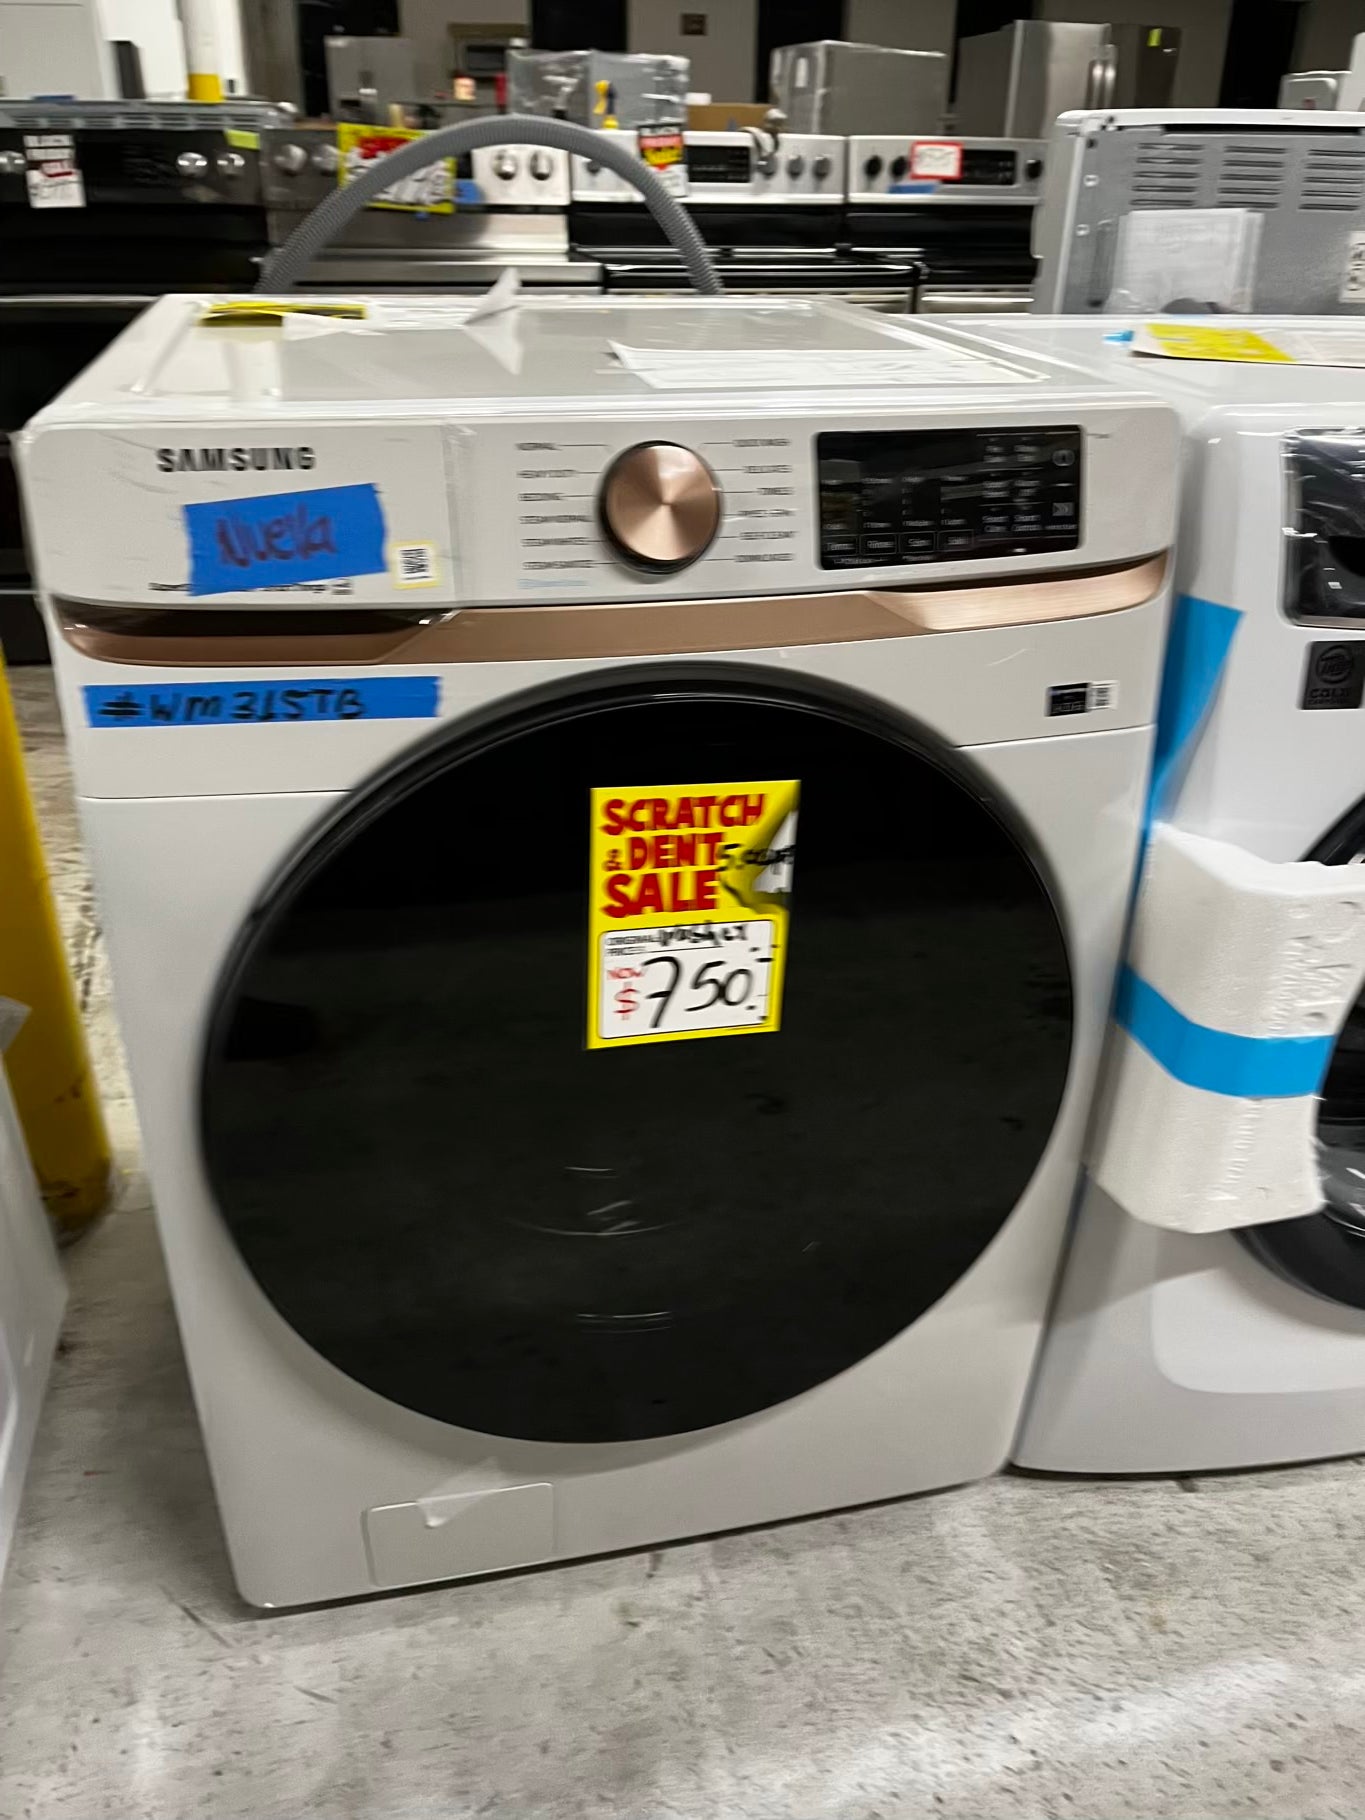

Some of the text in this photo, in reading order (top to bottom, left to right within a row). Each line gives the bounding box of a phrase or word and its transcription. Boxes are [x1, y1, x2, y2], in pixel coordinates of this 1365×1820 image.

[156, 446, 316, 473] SAMSUNG
[600, 793, 766, 836] SCRATCH
[605, 832, 725, 872] & DENT
[601, 869, 720, 919] SALE
[608, 967, 645, 980] NOW
